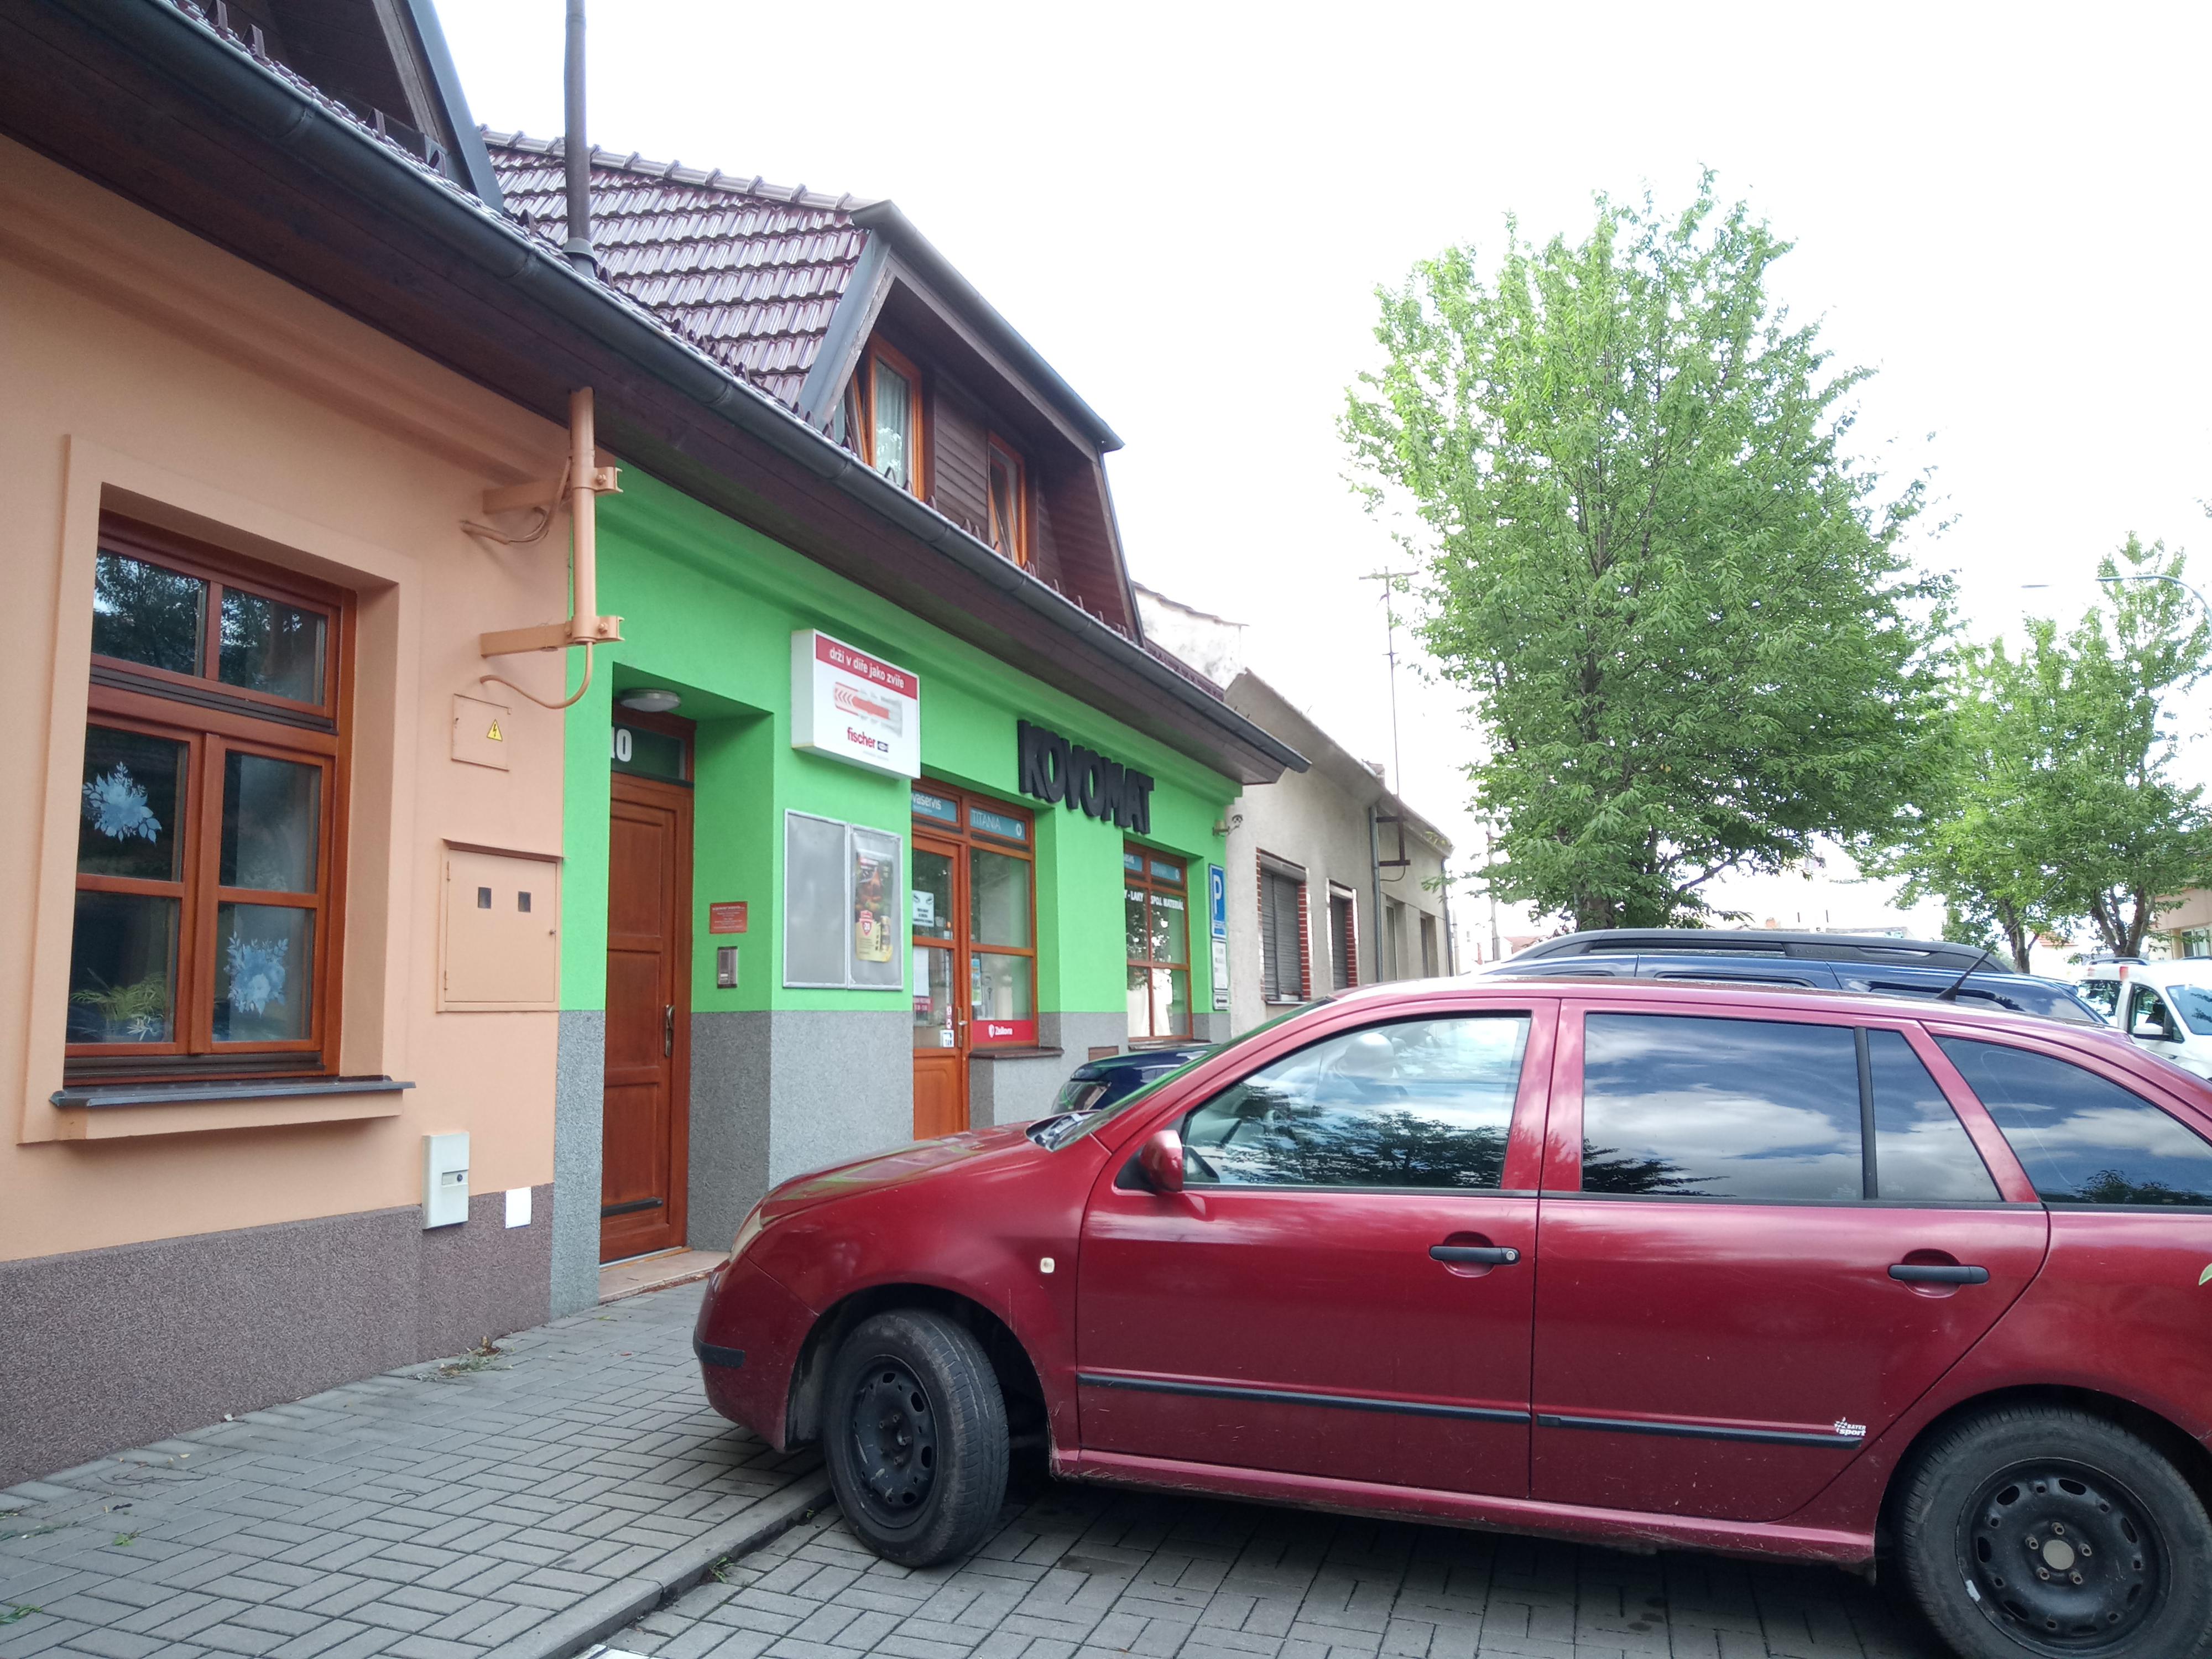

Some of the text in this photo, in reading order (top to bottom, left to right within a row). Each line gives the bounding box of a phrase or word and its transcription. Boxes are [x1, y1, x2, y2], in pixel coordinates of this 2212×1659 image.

[846, 655, 852, 666] v
[869, 663, 885, 681] jako
[847, 727, 876, 748] fischer
[1016, 719, 1155, 834] KOVOMAT
[972, 809, 1001, 831] TITANIA
[1130, 891, 1144, 902] LAKY
[1213, 874, 1222, 915] P
